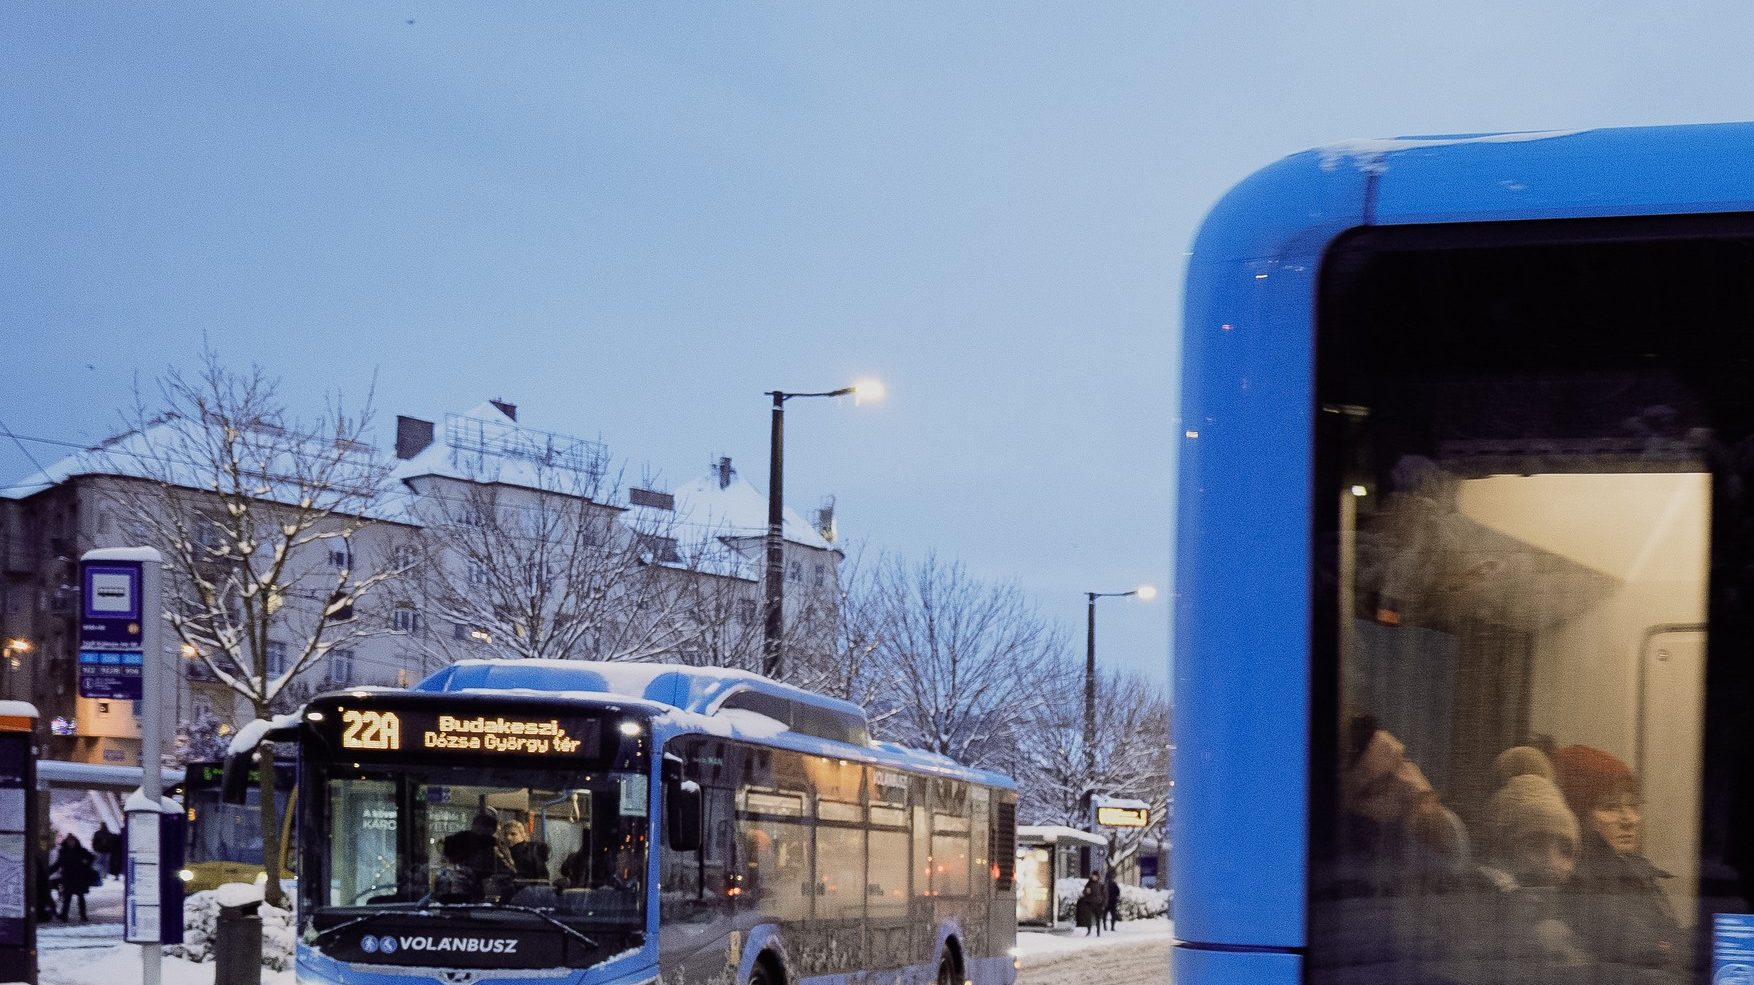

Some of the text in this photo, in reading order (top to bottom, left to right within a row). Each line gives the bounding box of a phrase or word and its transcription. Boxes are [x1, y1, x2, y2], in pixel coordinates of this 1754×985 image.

[343, 710, 399, 749] 22A
[439, 716, 565, 735] Budakeszi,
[424, 732, 581, 752] Dózsa György tér
[400, 937, 518, 952] VOLÁNBUSZ
